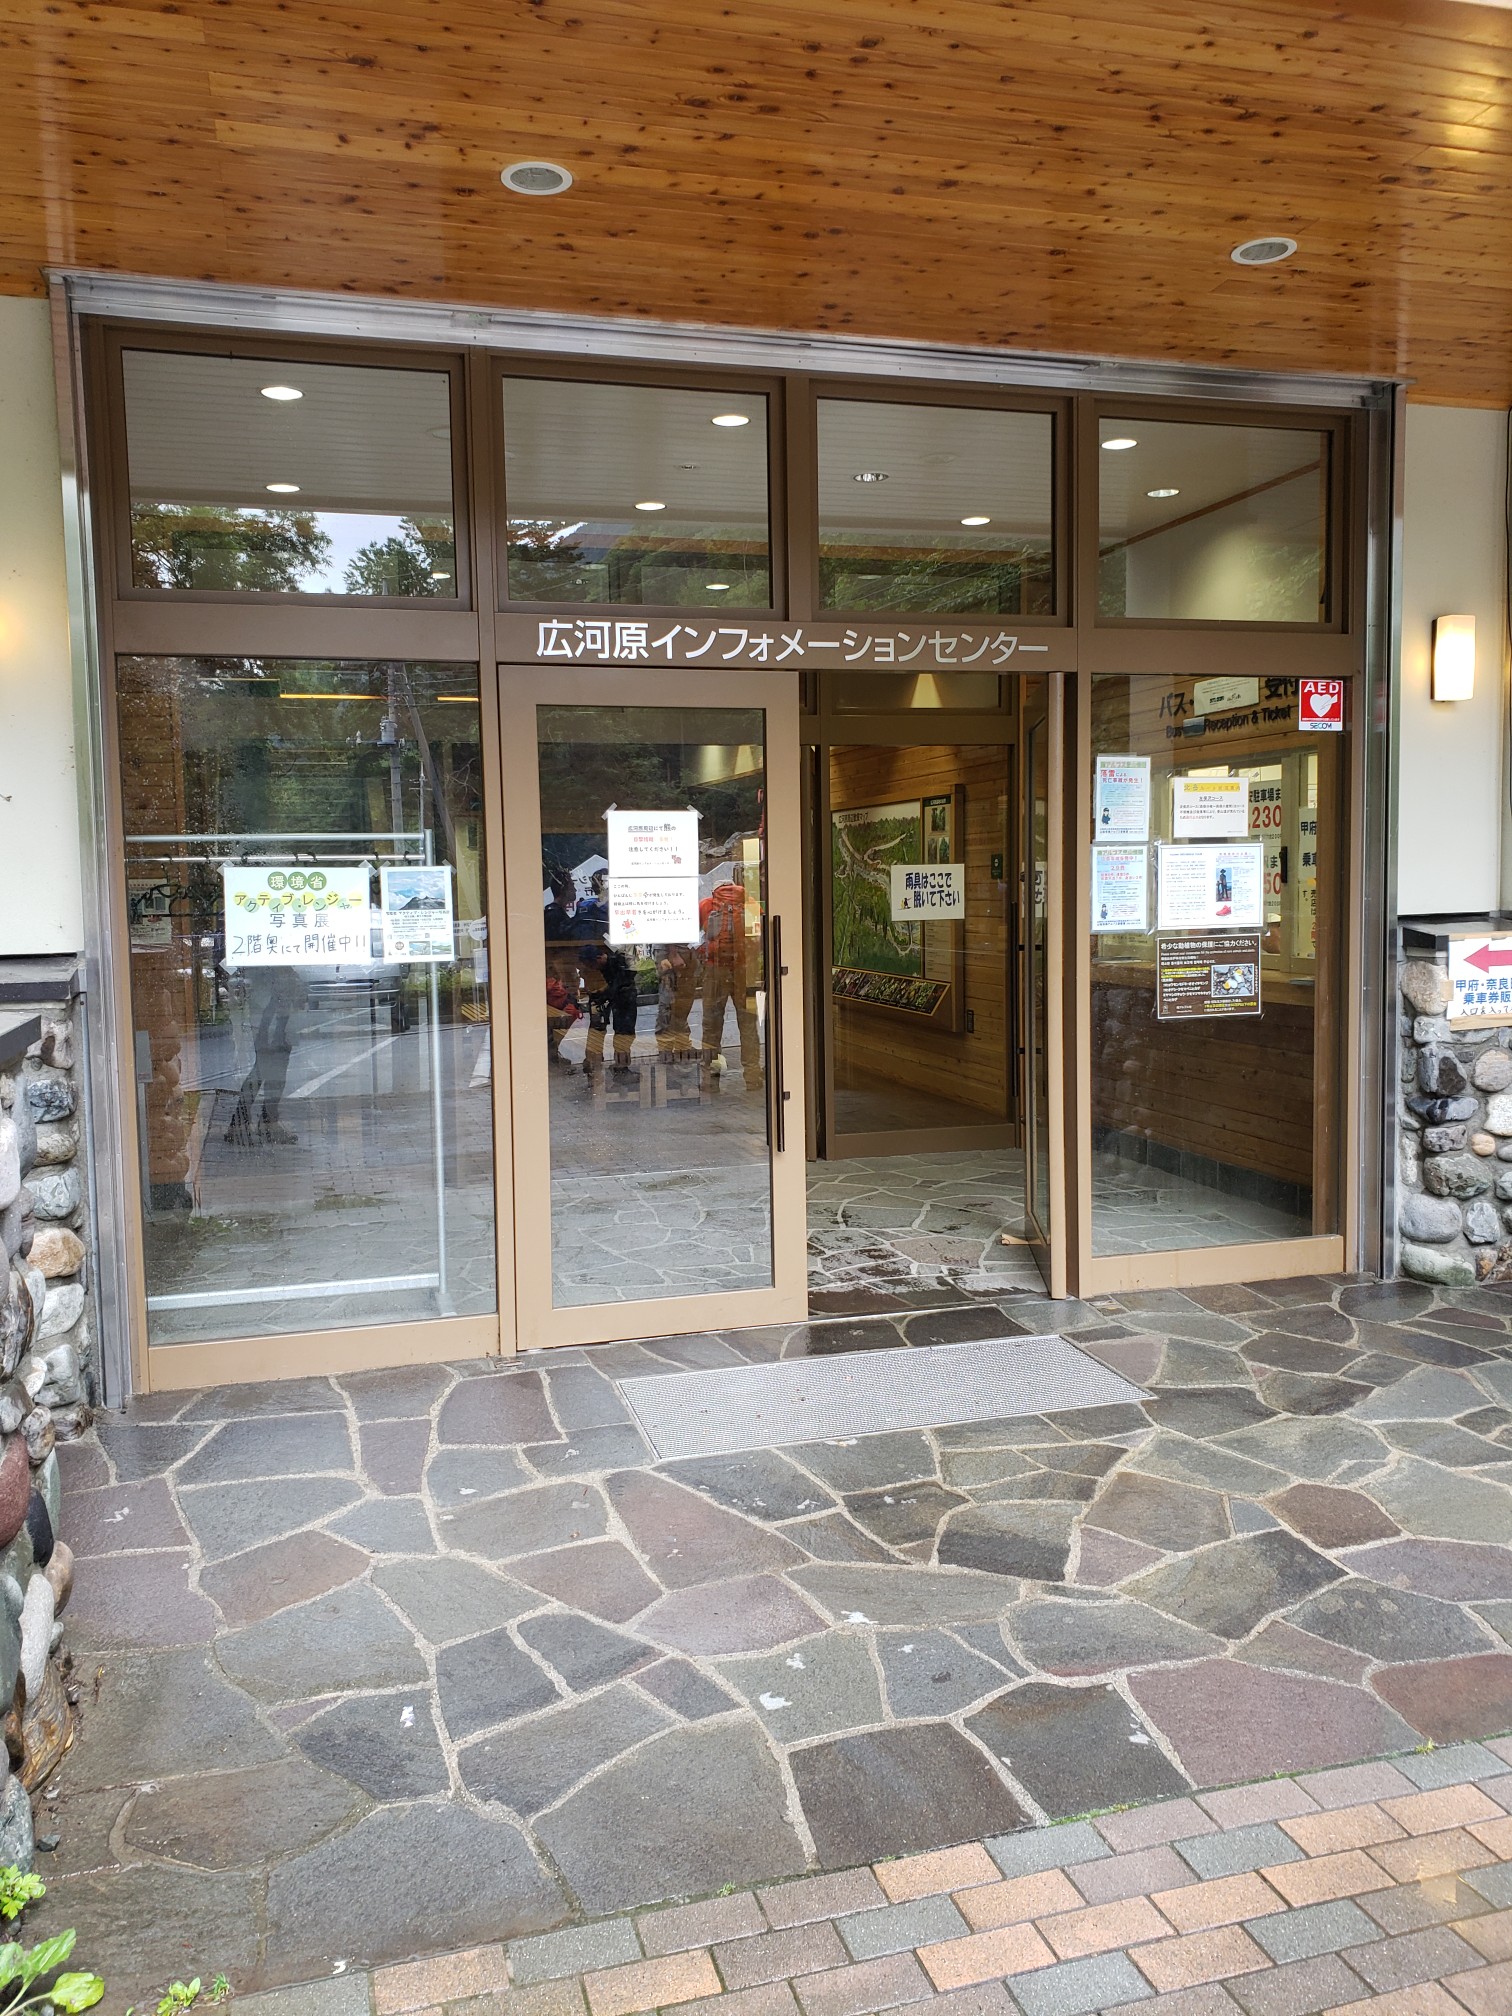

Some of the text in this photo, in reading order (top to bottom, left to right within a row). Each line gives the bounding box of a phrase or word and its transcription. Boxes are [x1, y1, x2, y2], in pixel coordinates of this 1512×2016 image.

[537, 619, 1048, 665] 広河原インフォメーションセンター
[1303, 682, 1339, 693] AED
[1204, 712, 1249, 733] Reception
[1251, 710, 1259, 724] &
[1262, 704, 1291, 723] Ticket
[1309, 722, 1333, 730] SECOM
[271, 875, 323, 889] 環境省
[905, 872, 952, 890] 雨具はここで
[234, 893, 362, 912] アクティブ・レンジャー
[914, 890, 960, 908] 脱いて下さい
[270, 913, 329, 928] 写真展
[1456, 977, 1512, 992] 甲府・奈良
[1463, 990, 1511, 1005] 乗車券販
